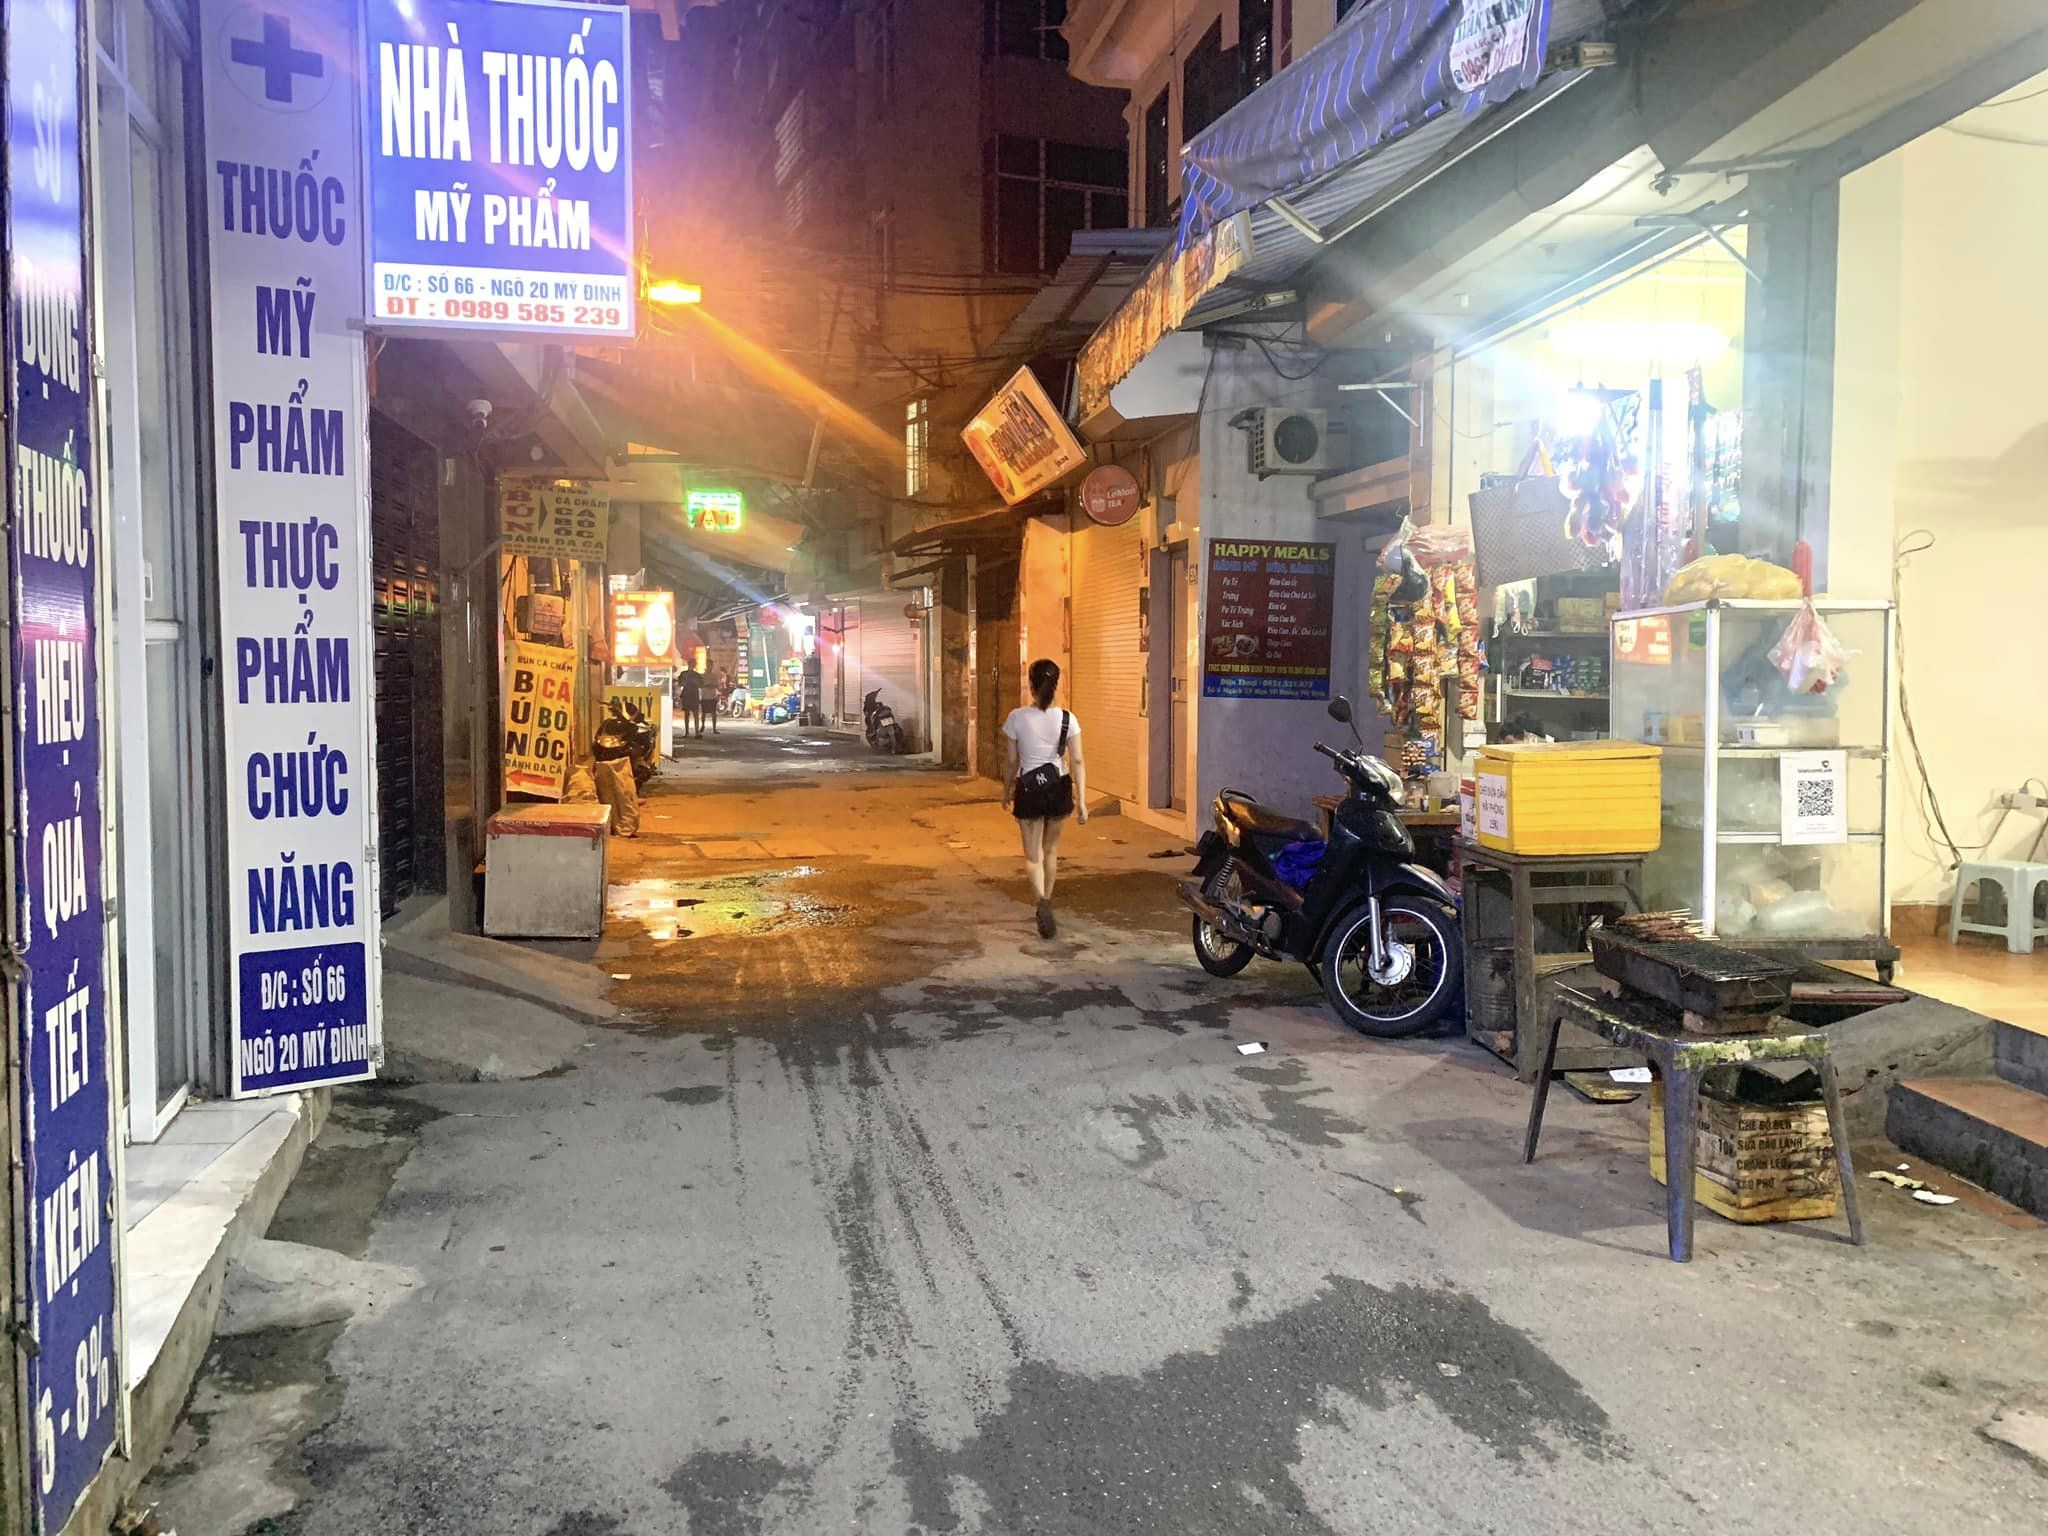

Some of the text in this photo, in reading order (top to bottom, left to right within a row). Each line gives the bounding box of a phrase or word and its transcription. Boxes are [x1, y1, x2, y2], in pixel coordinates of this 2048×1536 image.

[380, 18, 618, 174] NHÀ THUỐC
[216, 150, 345, 246] THUỐC
[415, 177, 590, 251] MỸ PHẨM
[256, 276, 316, 359] MỸ
[384, 273, 411, 292] Đ/C
[455, 277, 474, 295] 66
[529, 281, 549, 299] 20
[386, 296, 419, 316] ĐT
[445, 299, 509, 320] 0989
[518, 302, 565, 323] 585
[574, 305, 620, 326] 239
[230, 378, 344, 476] PHẨM
[18, 428, 88, 568] THUỐC
[239, 517, 339, 604] THỰC
[1215, 543, 1329, 560] HAPPY MEALS
[35, 616, 85, 765] HIỆU
[237, 609, 350, 704] PHẨM
[542, 674, 570, 704] CÁ
[534, 730, 565, 761] ỐC
[538, 705, 568, 731] BÒ
[247, 731, 349, 820] CHỨC
[42, 781, 88, 940] QUẢ
[248, 851, 354, 934] NĂNG
[261, 971, 289, 1010] Đ/C
[302, 953, 323, 1006] SỐ
[327, 964, 345, 1003] 66
[46, 957, 89, 1112] TIẾT
[241, 1018, 367, 1077] NGÕ 20 MỸ ĐÌNH
[44, 1150, 99, 1304] KIỆM
